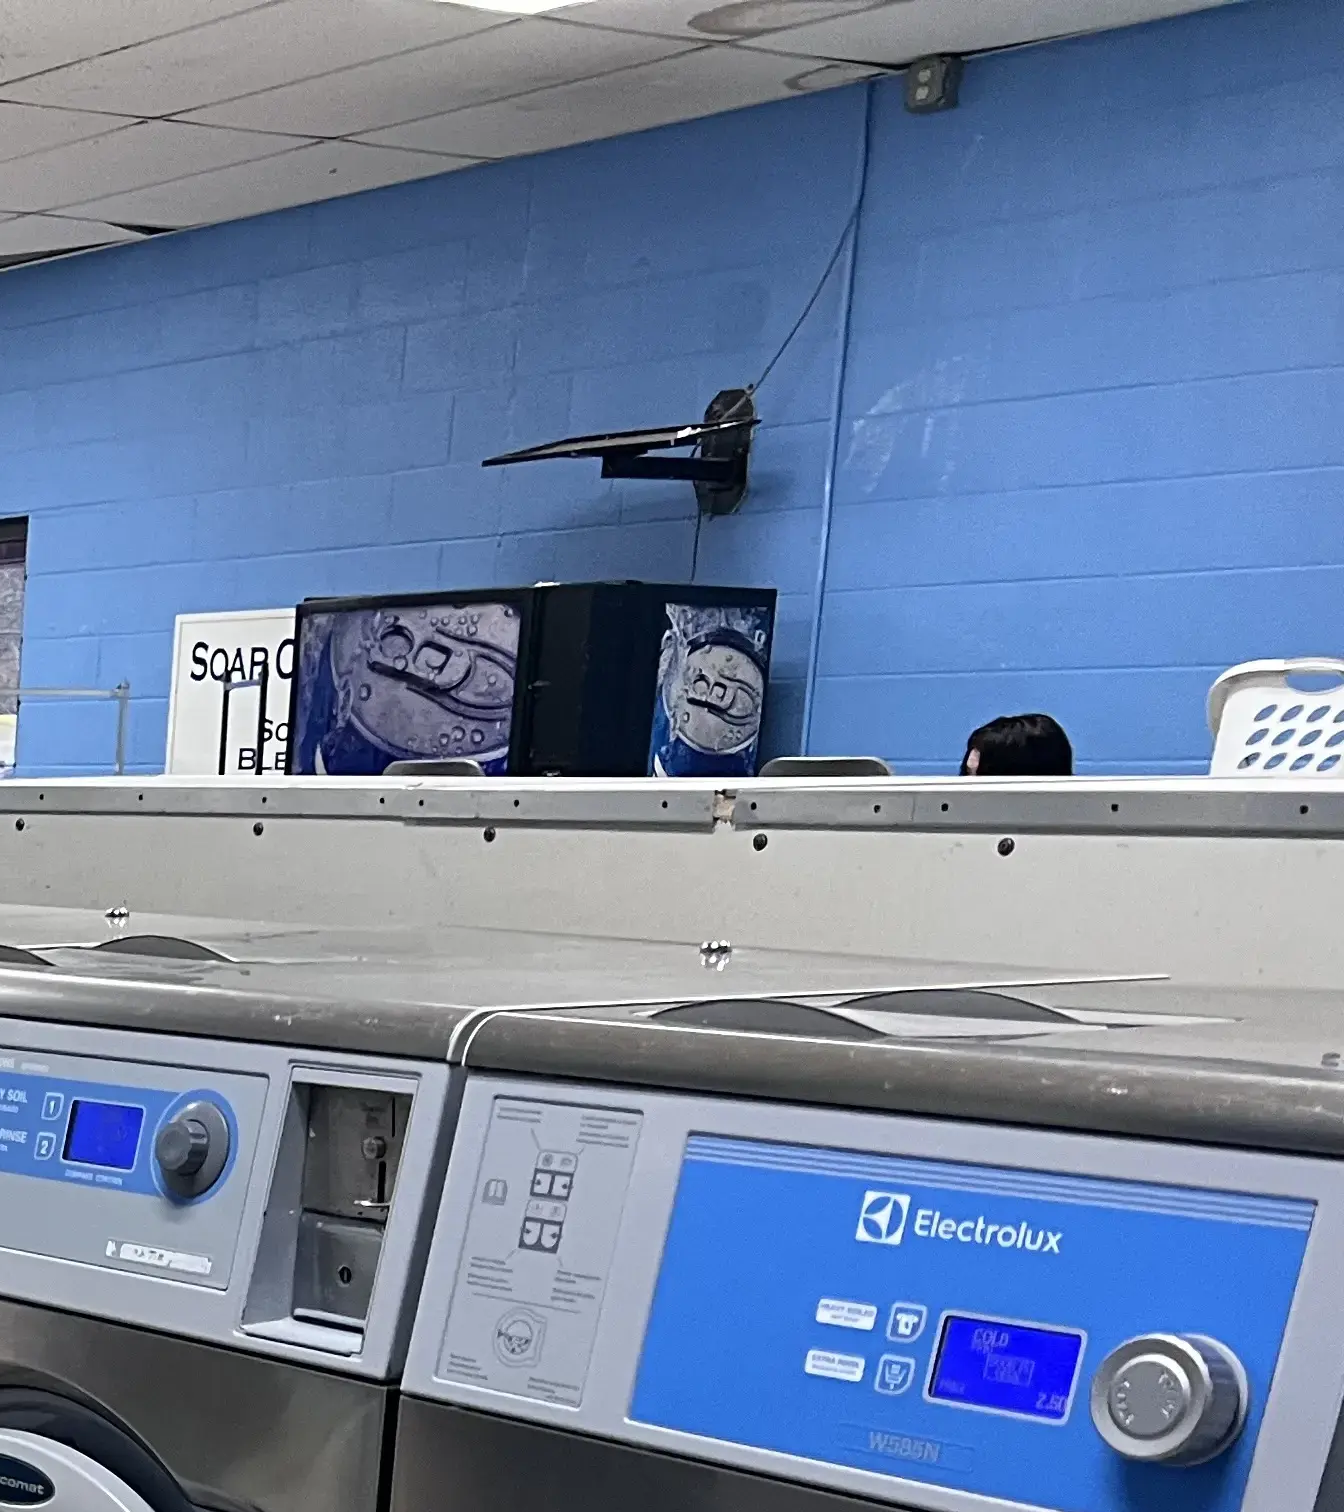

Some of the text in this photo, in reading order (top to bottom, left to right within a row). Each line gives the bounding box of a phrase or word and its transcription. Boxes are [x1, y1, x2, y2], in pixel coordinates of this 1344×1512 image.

[190, 641, 269, 681] SOAP
[7, 1088, 28, 1104] SOIL
[0, 1128, 28, 1144] RINSE
[40, 1140, 49, 1155] 2
[914, 1208, 1062, 1254] Electrolux
